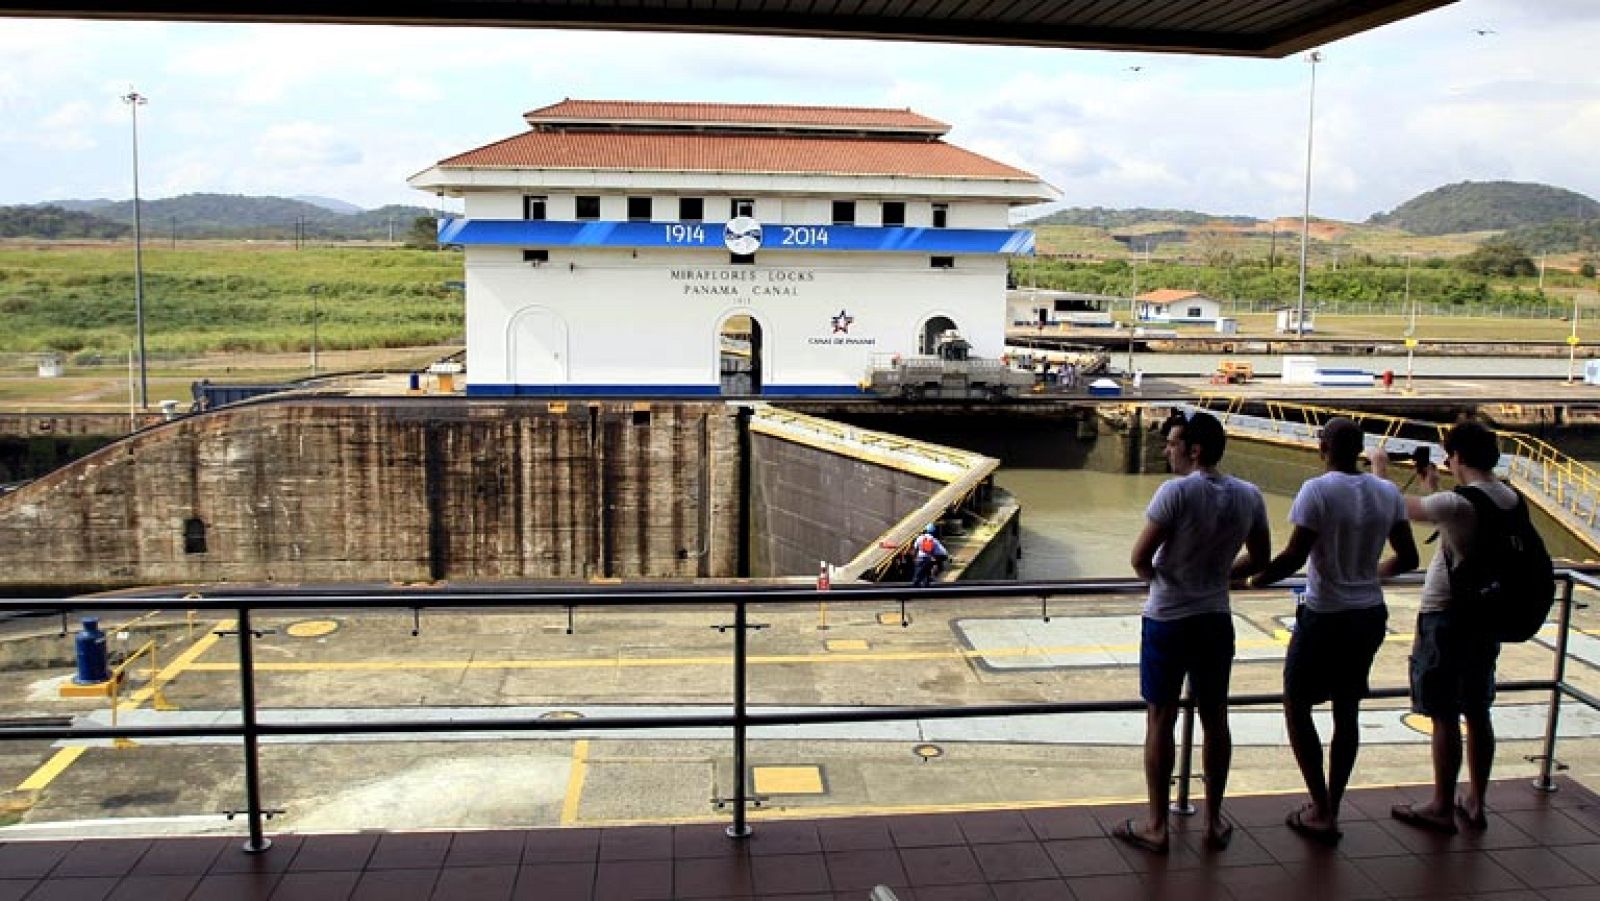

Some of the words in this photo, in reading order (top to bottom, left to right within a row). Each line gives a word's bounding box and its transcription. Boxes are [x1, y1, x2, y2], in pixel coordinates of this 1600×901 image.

[665, 224, 705, 243] 1914
[782, 226, 829, 246] 2014
[670, 269, 756, 281] MIRAFLORES
[768, 269, 815, 281] LOCKS
[683, 284, 739, 295] PANAMA
[752, 285, 799, 296] CANAL
